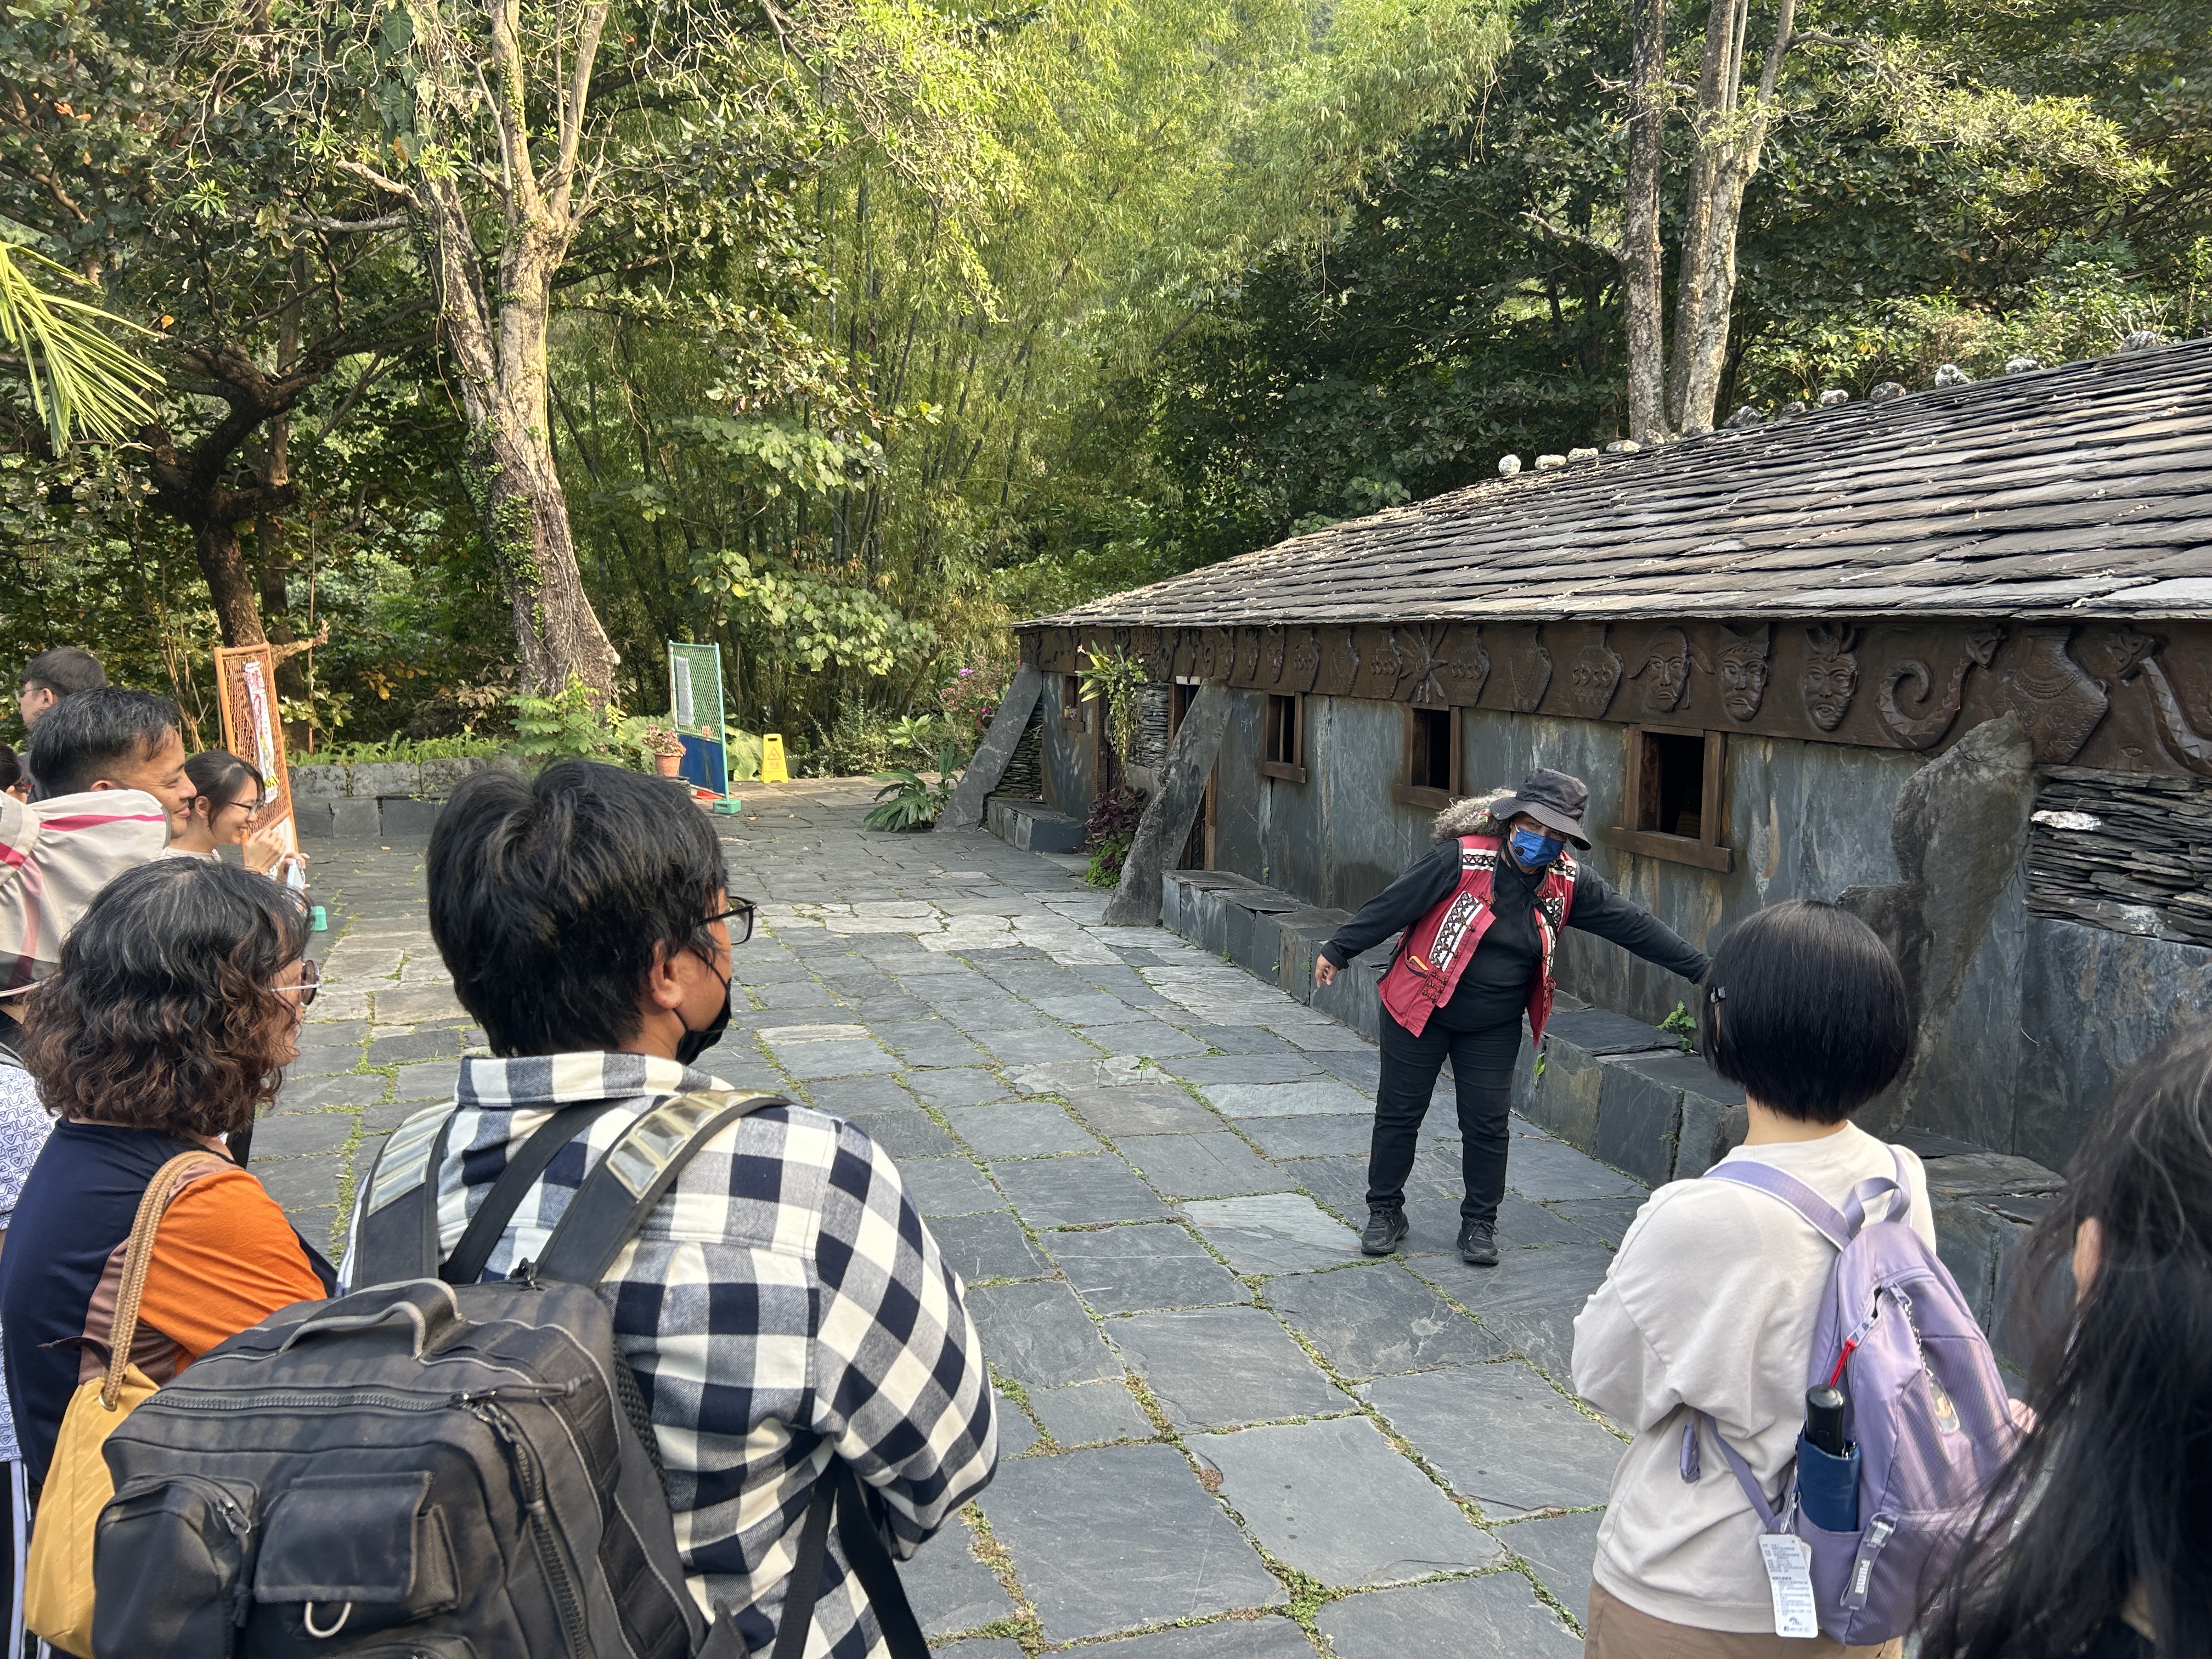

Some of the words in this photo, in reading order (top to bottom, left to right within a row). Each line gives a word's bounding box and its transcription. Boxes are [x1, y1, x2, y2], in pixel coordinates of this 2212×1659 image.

[0, 1093, 29, 1108] ILA
[0, 1116, 36, 1135] FILA
[3, 1126, 40, 1145] FILA
[6, 1139, 42, 1158] FILA
[10, 1153, 38, 1167] ILA
